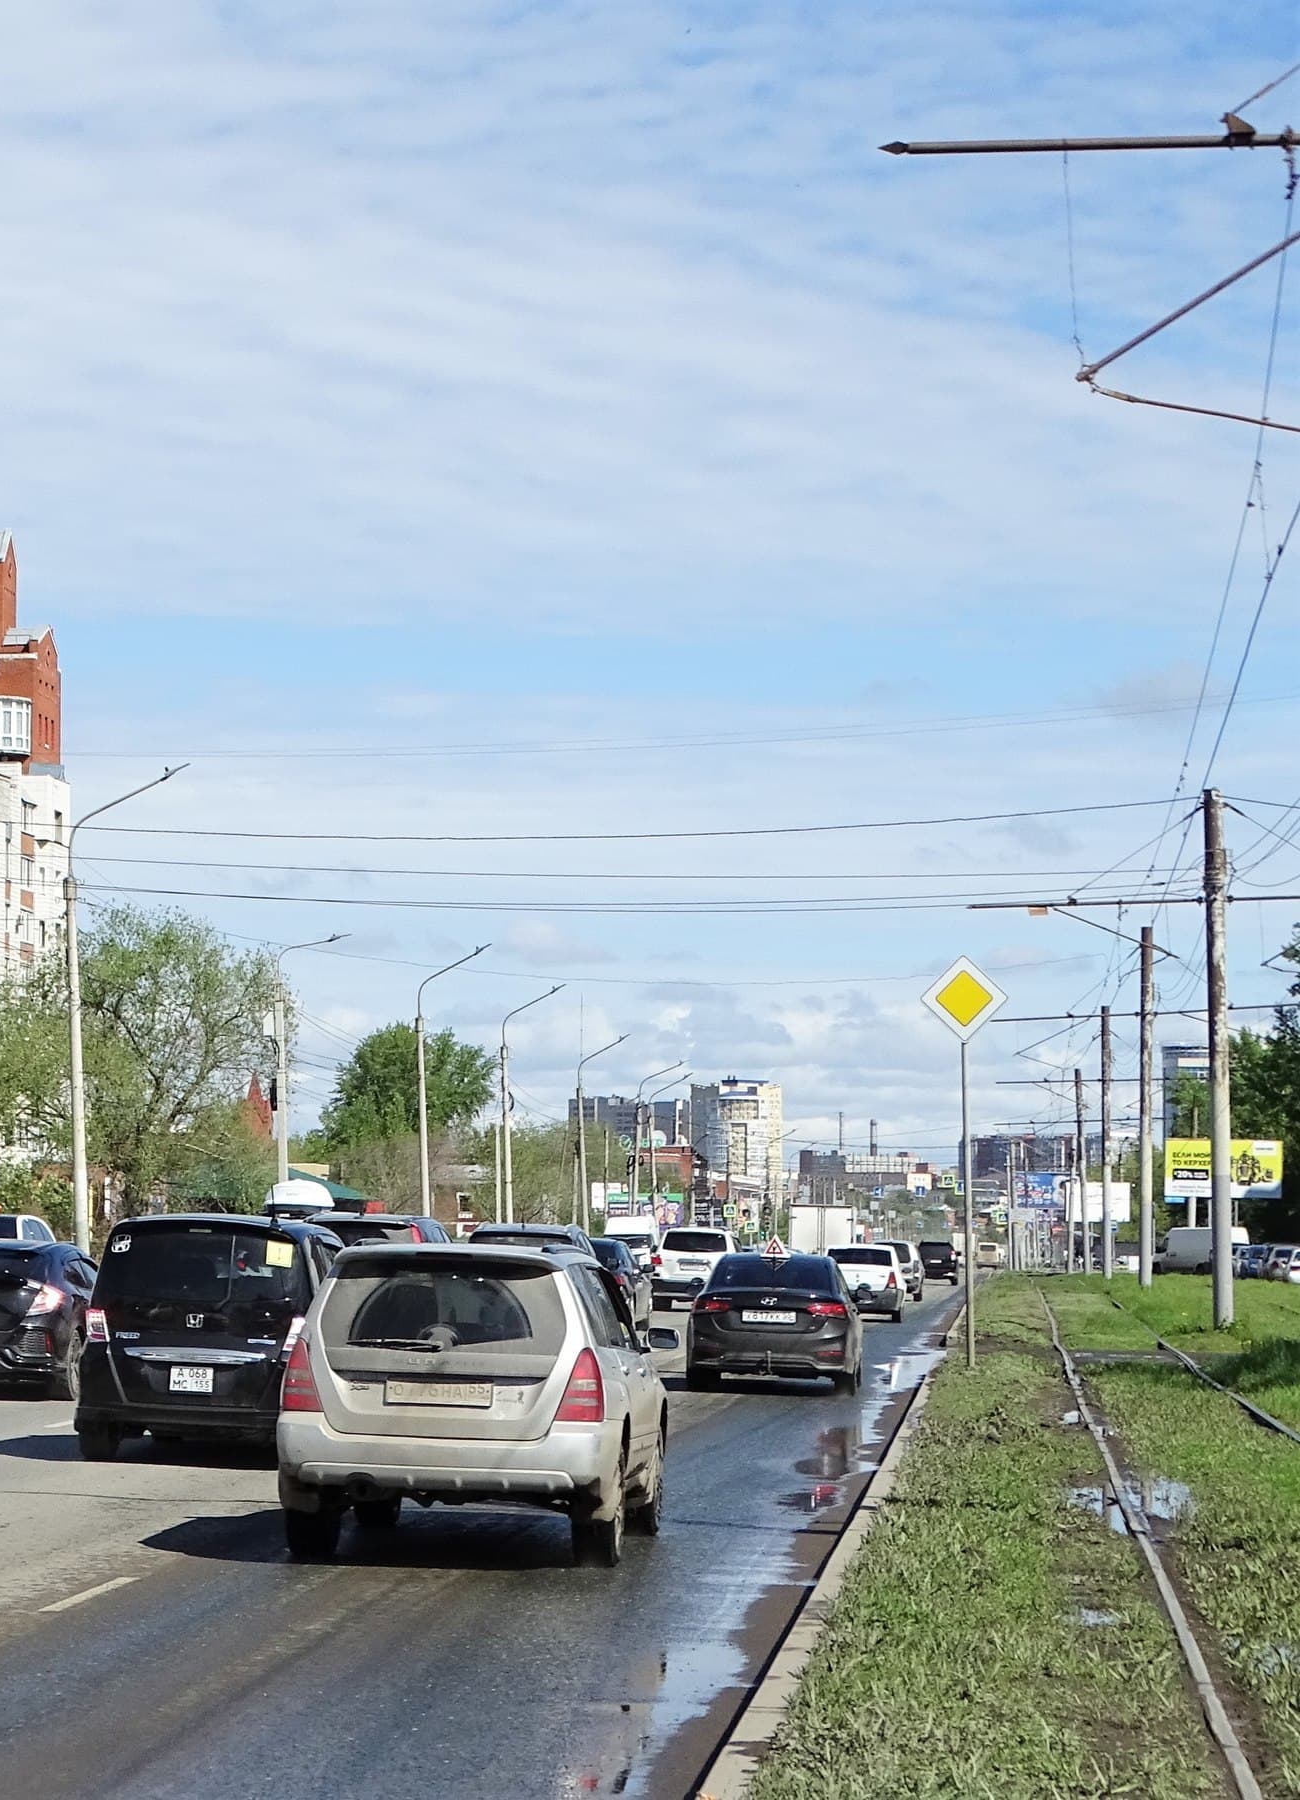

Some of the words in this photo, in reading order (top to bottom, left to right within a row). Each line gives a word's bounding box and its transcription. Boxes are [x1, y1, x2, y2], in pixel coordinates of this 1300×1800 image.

[177, 1369, 184, 1378] А
[188, 1368, 207, 1378] 068
[195, 1380, 210, 1389] 155
